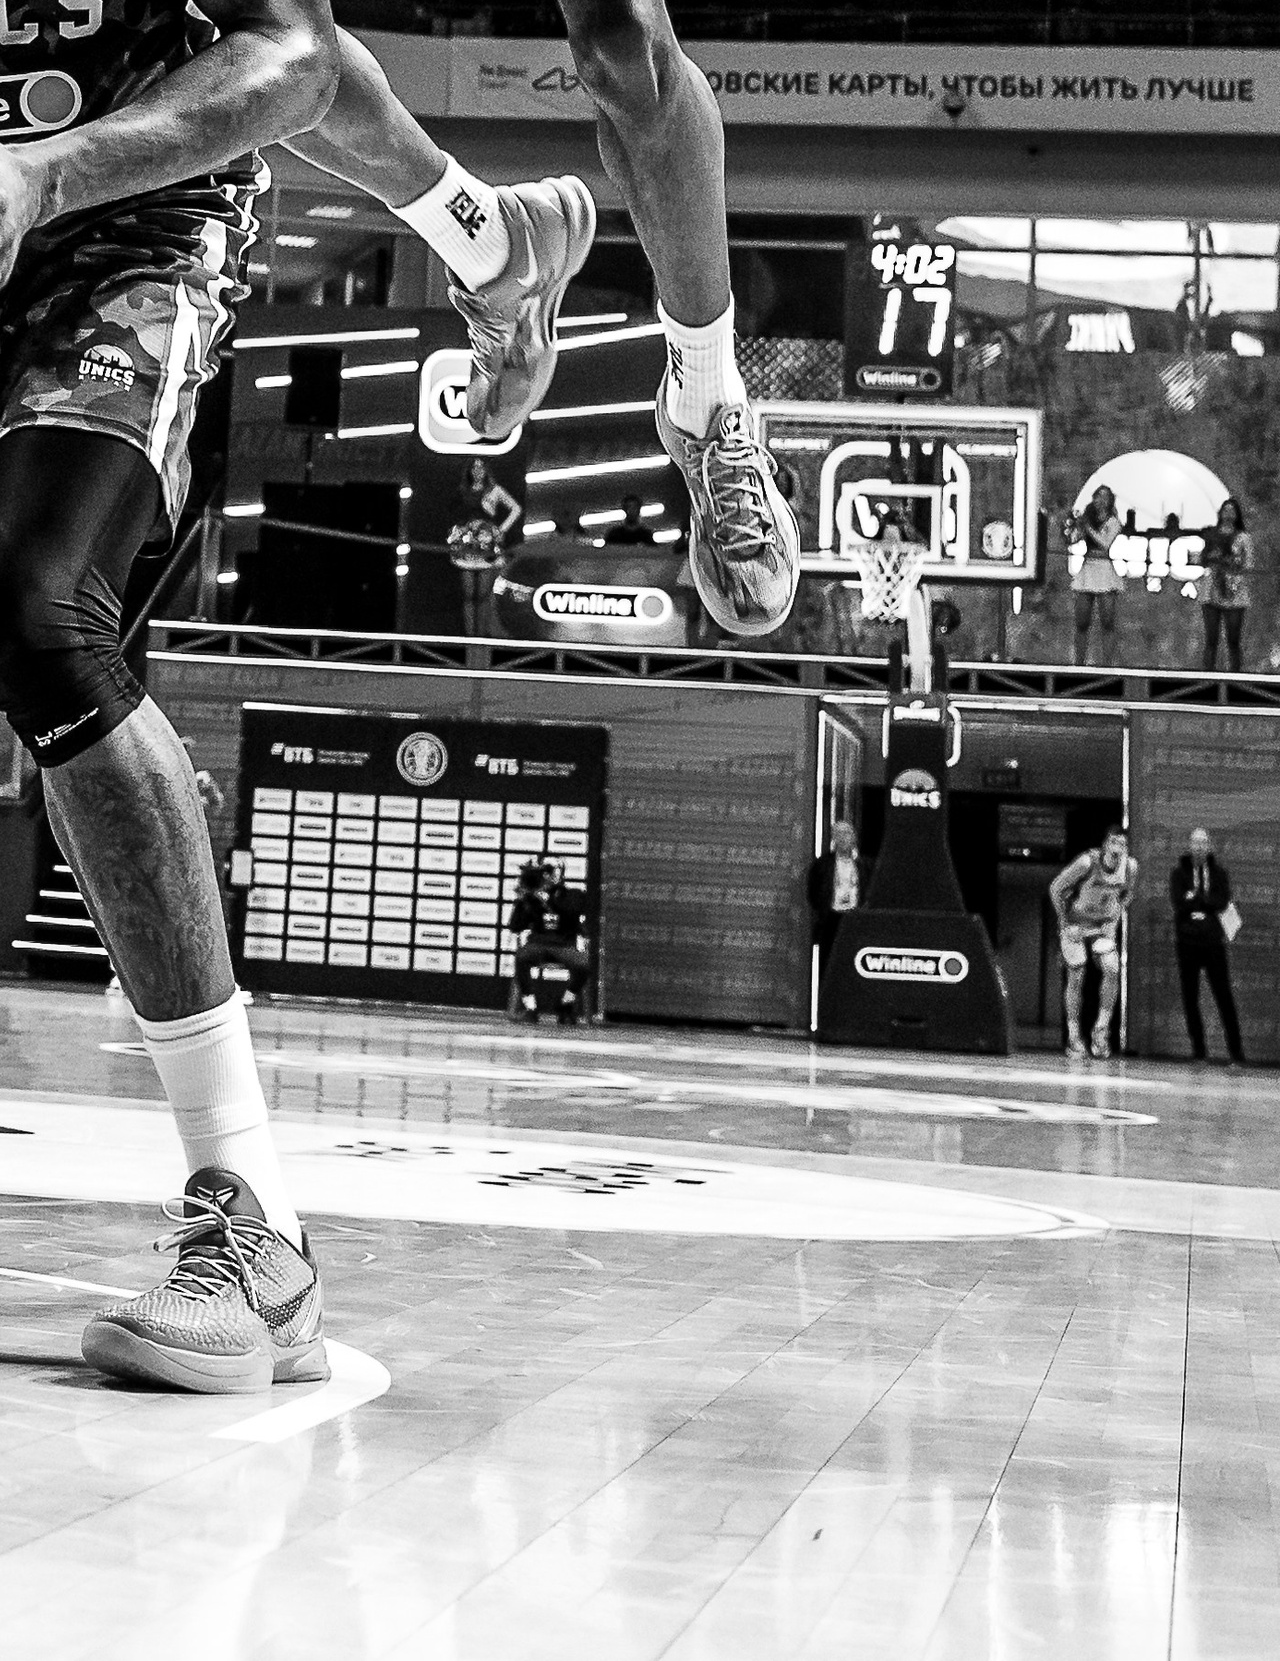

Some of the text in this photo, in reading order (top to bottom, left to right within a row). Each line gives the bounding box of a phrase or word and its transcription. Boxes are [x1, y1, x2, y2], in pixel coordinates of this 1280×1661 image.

[707, 70, 1255, 103] ОВСКИЕ КАРТЫ, ЧТОБЫ ЖИТЬ ЛУЧШЕ
[871, 243, 956, 285] 4:02
[878, 287, 952, 358] 17
[78, 359, 136, 387] UNICS
[545, 591, 633, 616] Winline
[865, 954, 937, 975] Winline
